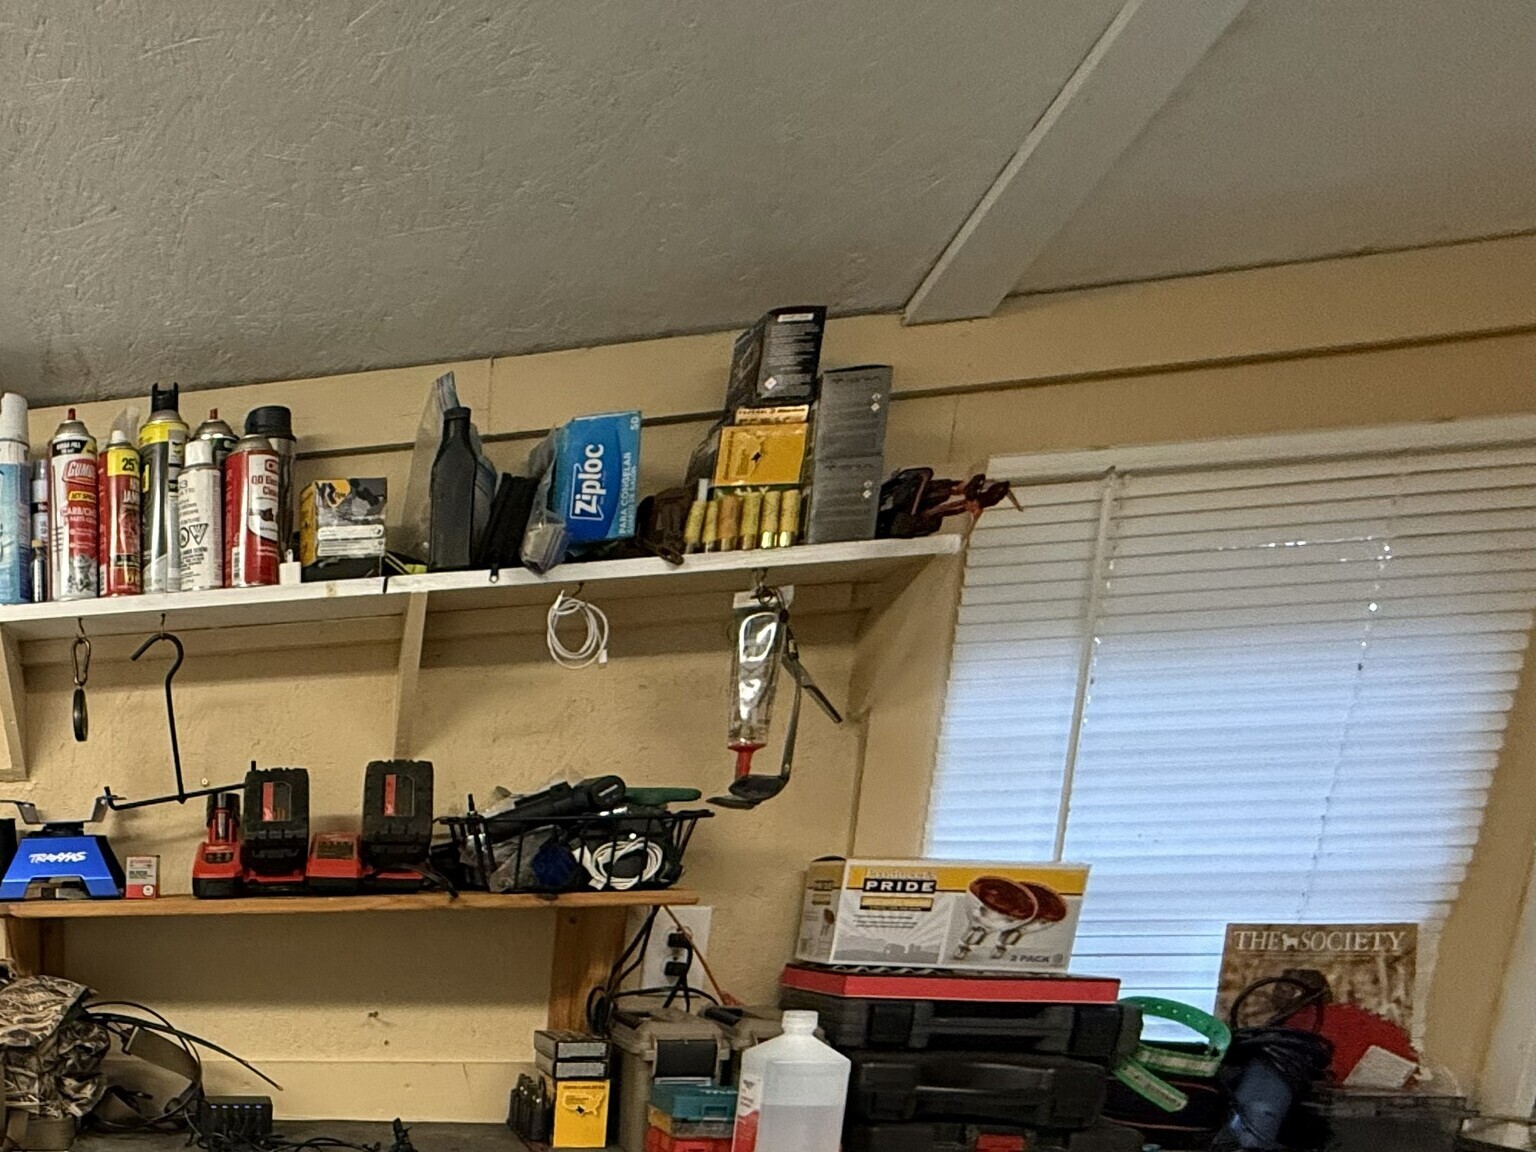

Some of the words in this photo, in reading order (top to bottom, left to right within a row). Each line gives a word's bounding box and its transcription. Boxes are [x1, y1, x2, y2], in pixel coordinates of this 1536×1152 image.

[574, 443, 607, 515] Ziploc
[29, 851, 87, 864] TRAXXAS
[865, 880, 936, 892] PRIDE
[1234, 931, 1282, 951] THE
[1300, 931, 1406, 951] SOCIETY
[1020, 954, 1050, 963] PACK
